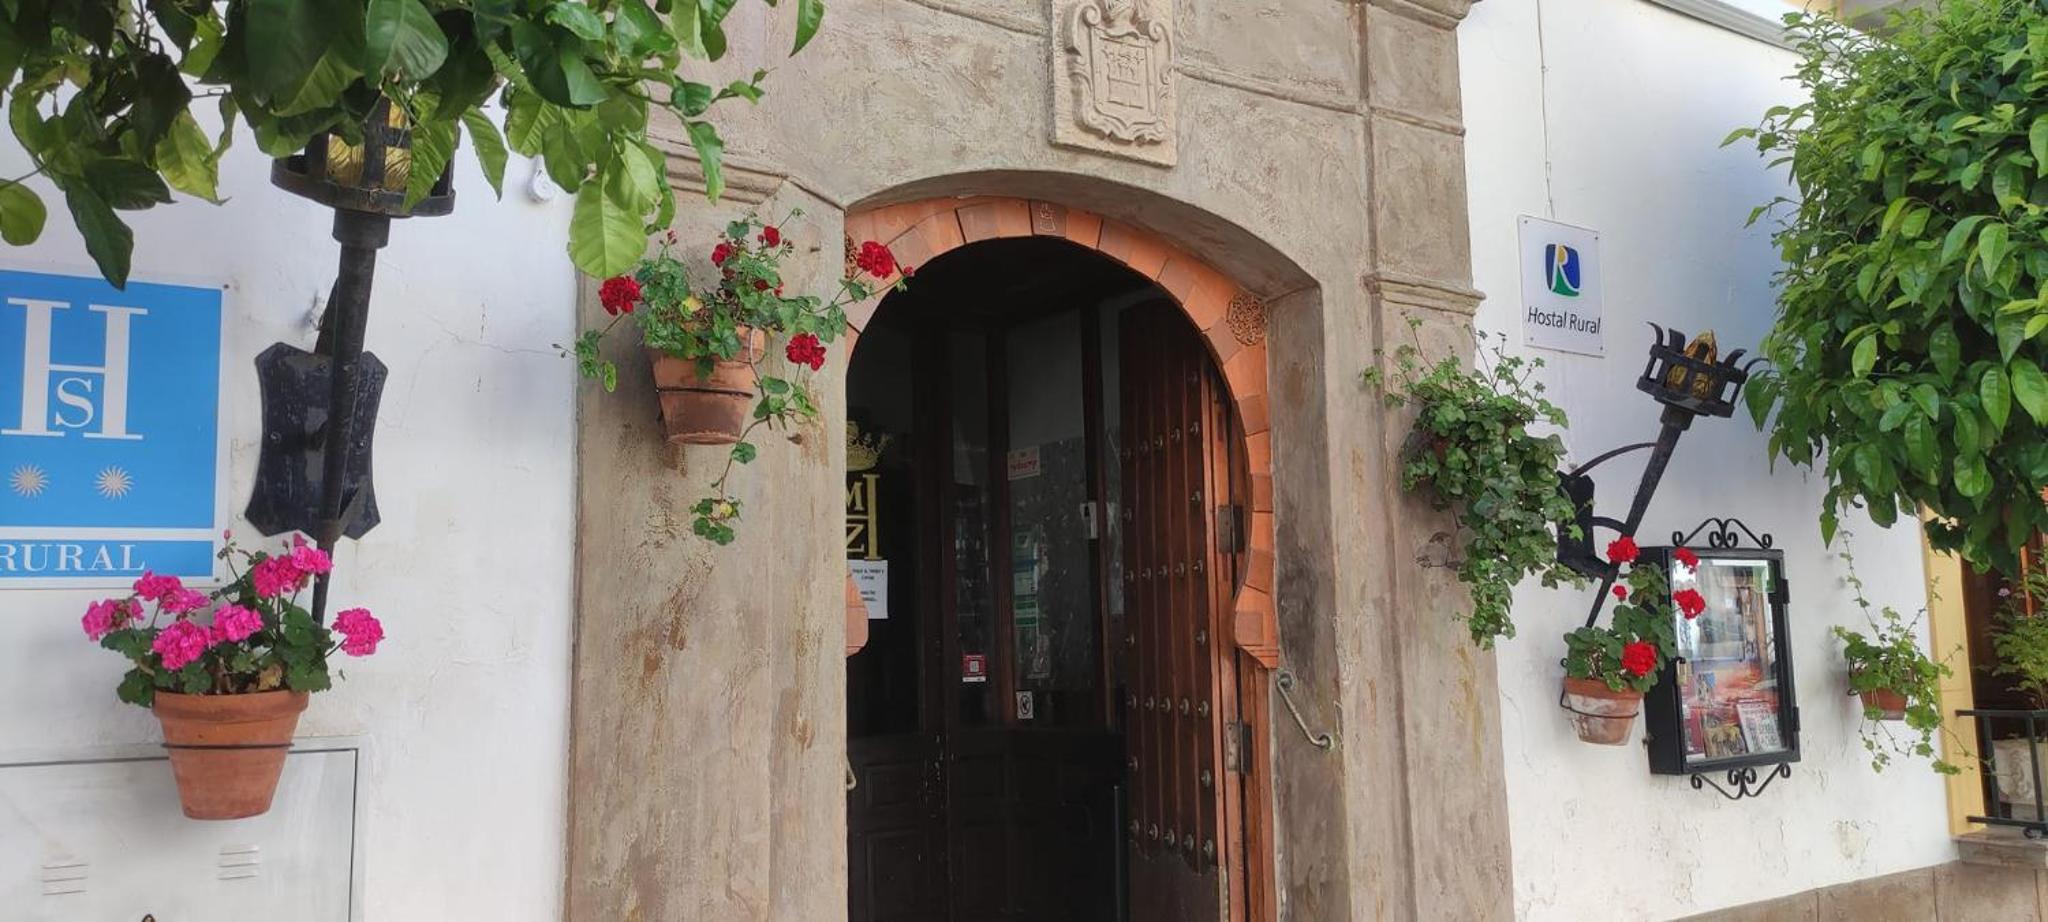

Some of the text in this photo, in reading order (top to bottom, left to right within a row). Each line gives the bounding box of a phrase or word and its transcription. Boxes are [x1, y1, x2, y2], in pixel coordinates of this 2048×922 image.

[1528, 307, 1600, 333] Hostal Rural
[55, 378, 94, 428] S
[0, 544, 146, 571] RURAL
